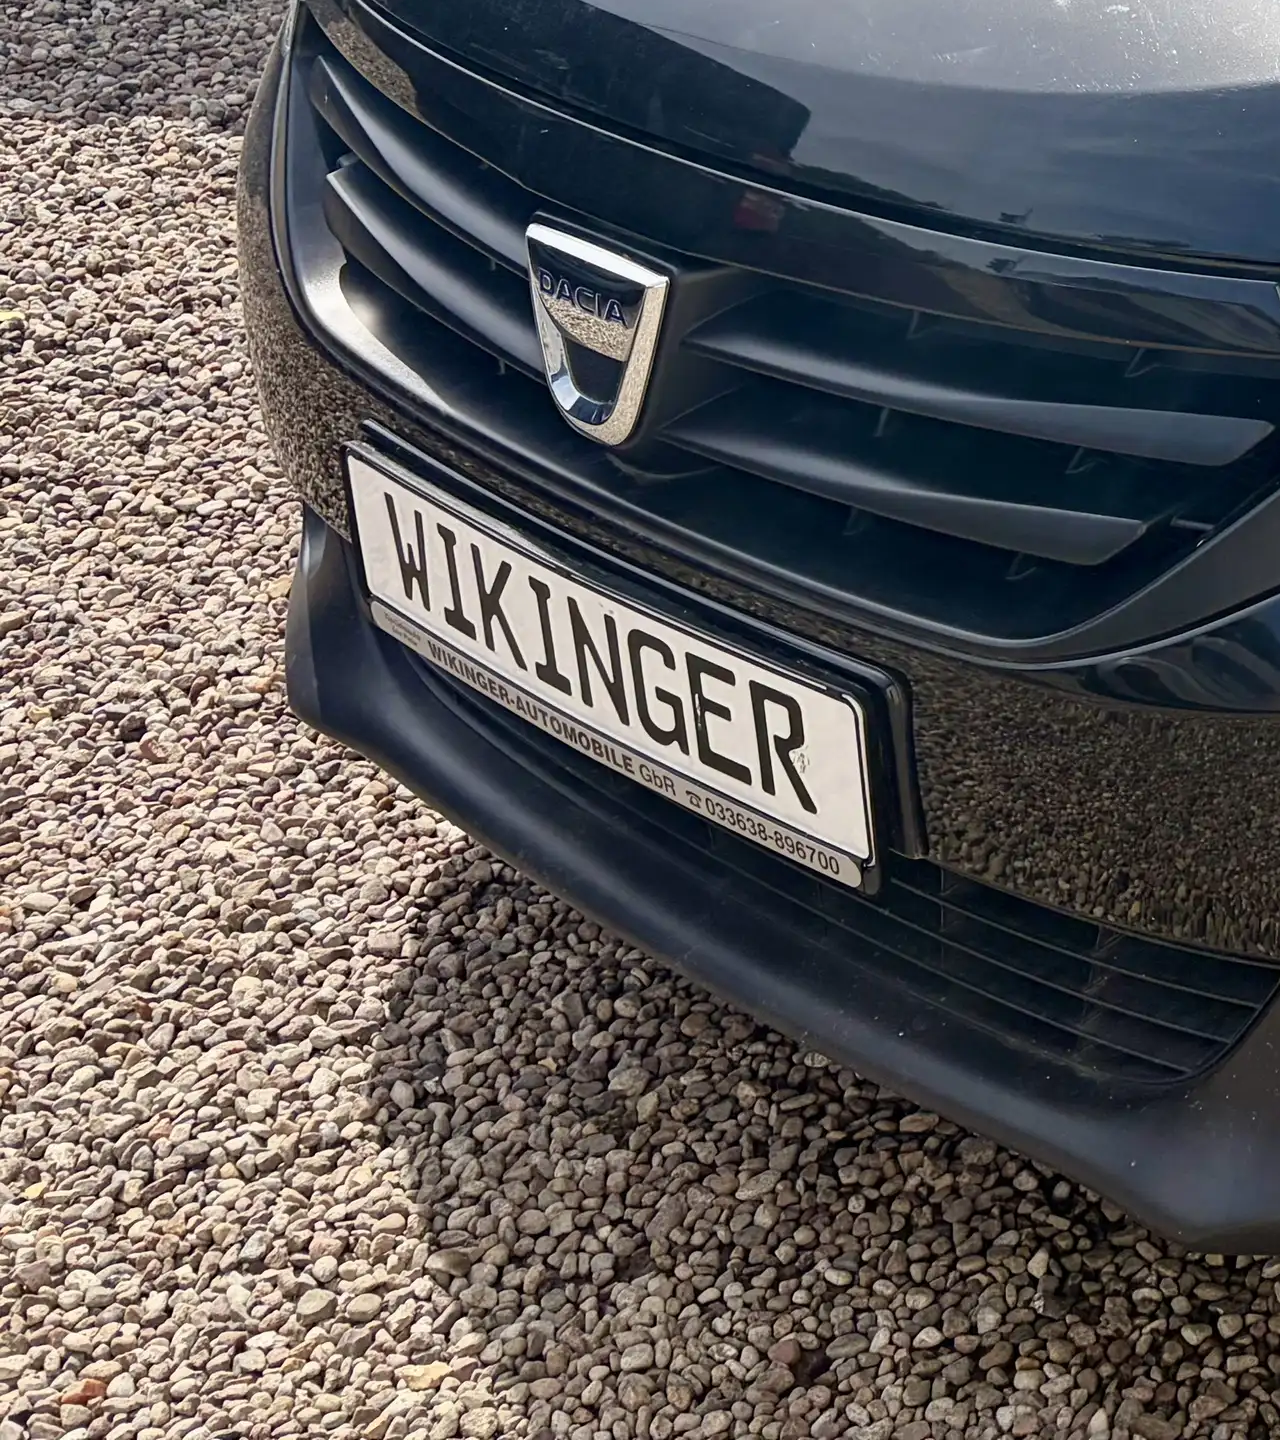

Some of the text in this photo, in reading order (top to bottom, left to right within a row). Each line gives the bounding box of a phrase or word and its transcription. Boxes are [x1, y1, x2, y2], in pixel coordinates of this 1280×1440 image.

[538, 266, 630, 330] DACIA
[385, 491, 817, 815] WIKINGER
[428, 640, 841, 876] WIKINGER-AUTOMOBILE GbR 033638-896700
